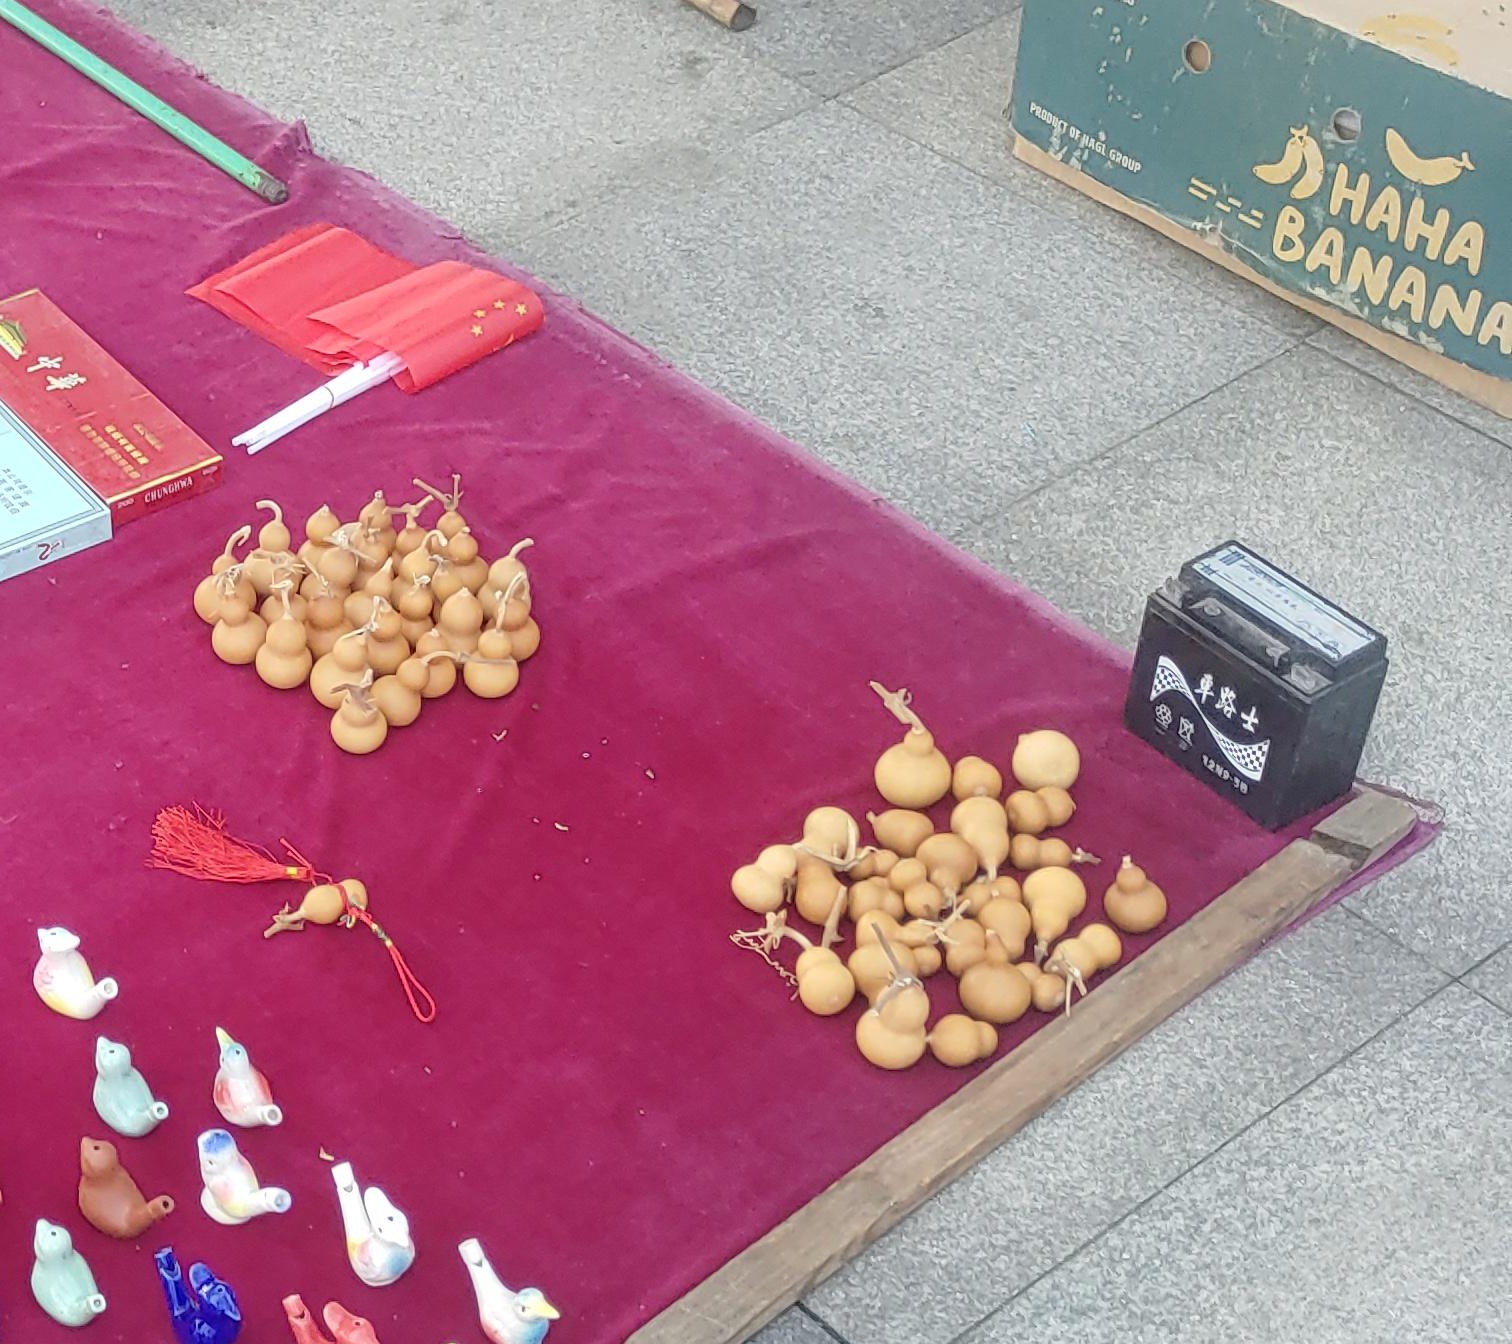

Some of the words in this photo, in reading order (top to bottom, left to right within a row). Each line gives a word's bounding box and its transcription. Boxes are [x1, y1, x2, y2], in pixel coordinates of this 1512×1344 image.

[1029, 101, 1068, 134] PRODUCT
[1069, 125, 1081, 141] OF
[1108, 148, 1142, 174] GROUP
[1329, 162, 1484, 276] HAHA
[1272, 205, 1512, 355] BANANA
[144, 475, 194, 504] CHUNGHWA
